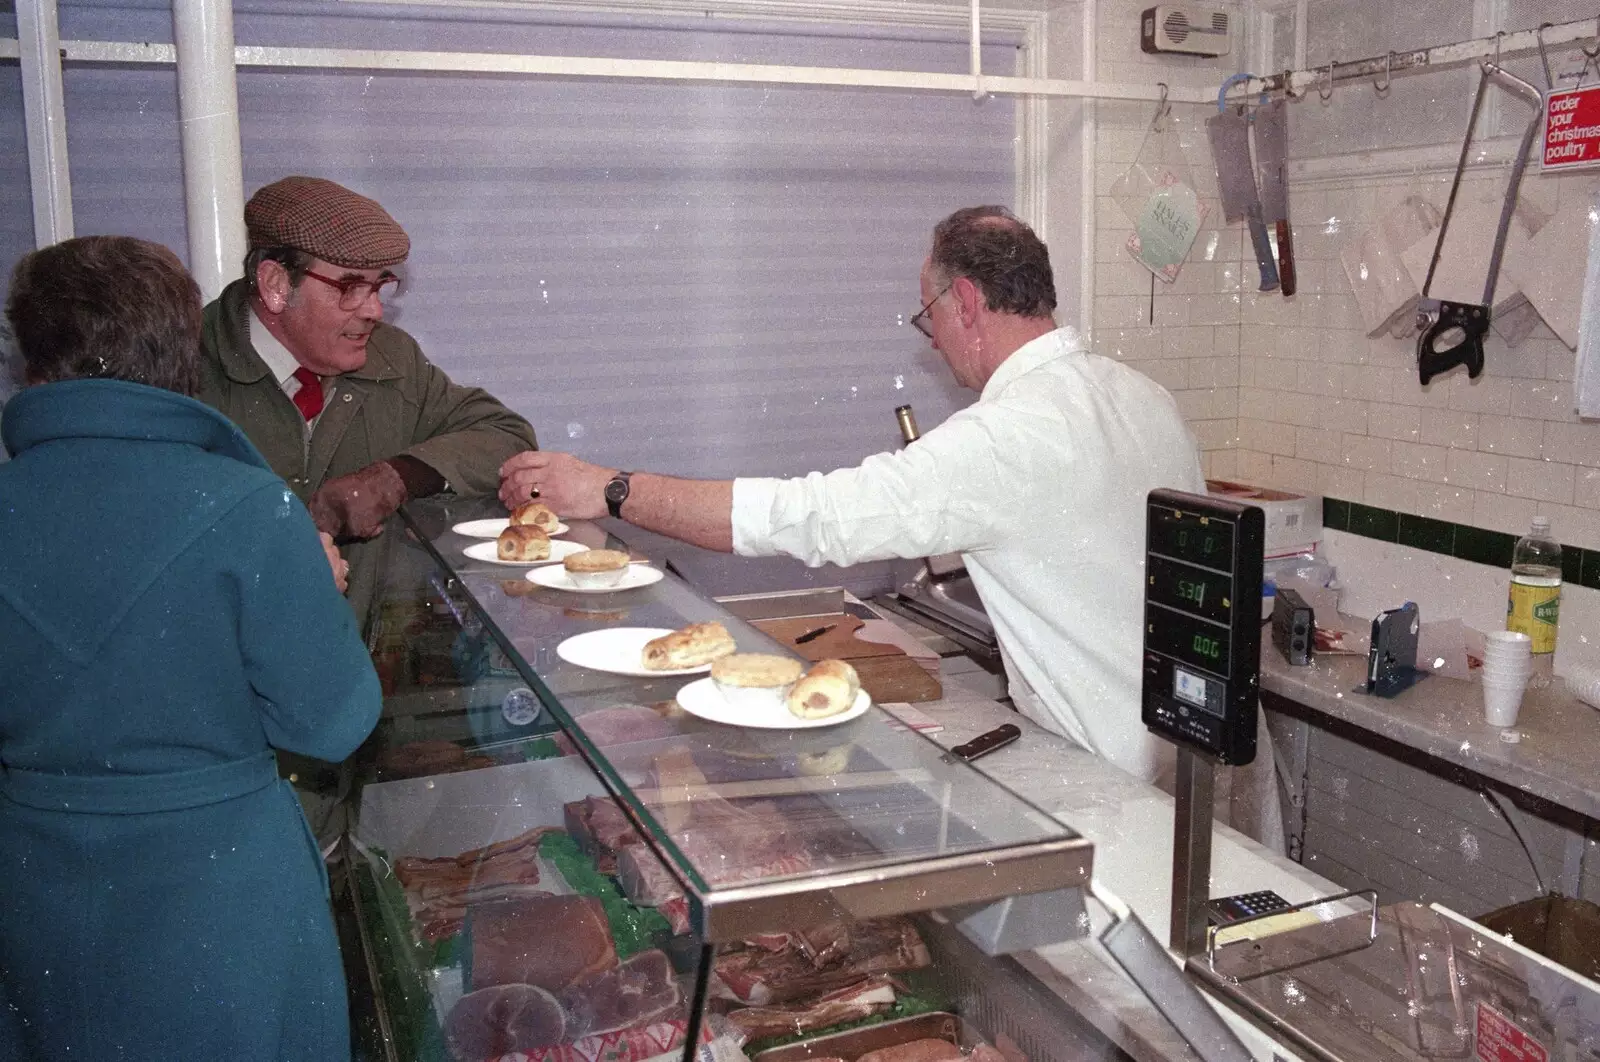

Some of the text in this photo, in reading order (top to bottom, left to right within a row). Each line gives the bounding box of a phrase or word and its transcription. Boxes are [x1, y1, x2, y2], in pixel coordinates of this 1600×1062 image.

[1550, 96, 1580, 112] order
[1549, 112, 1574, 130] your
[1548, 125, 1600, 144] christmas
[1546, 142, 1586, 161] poultry
